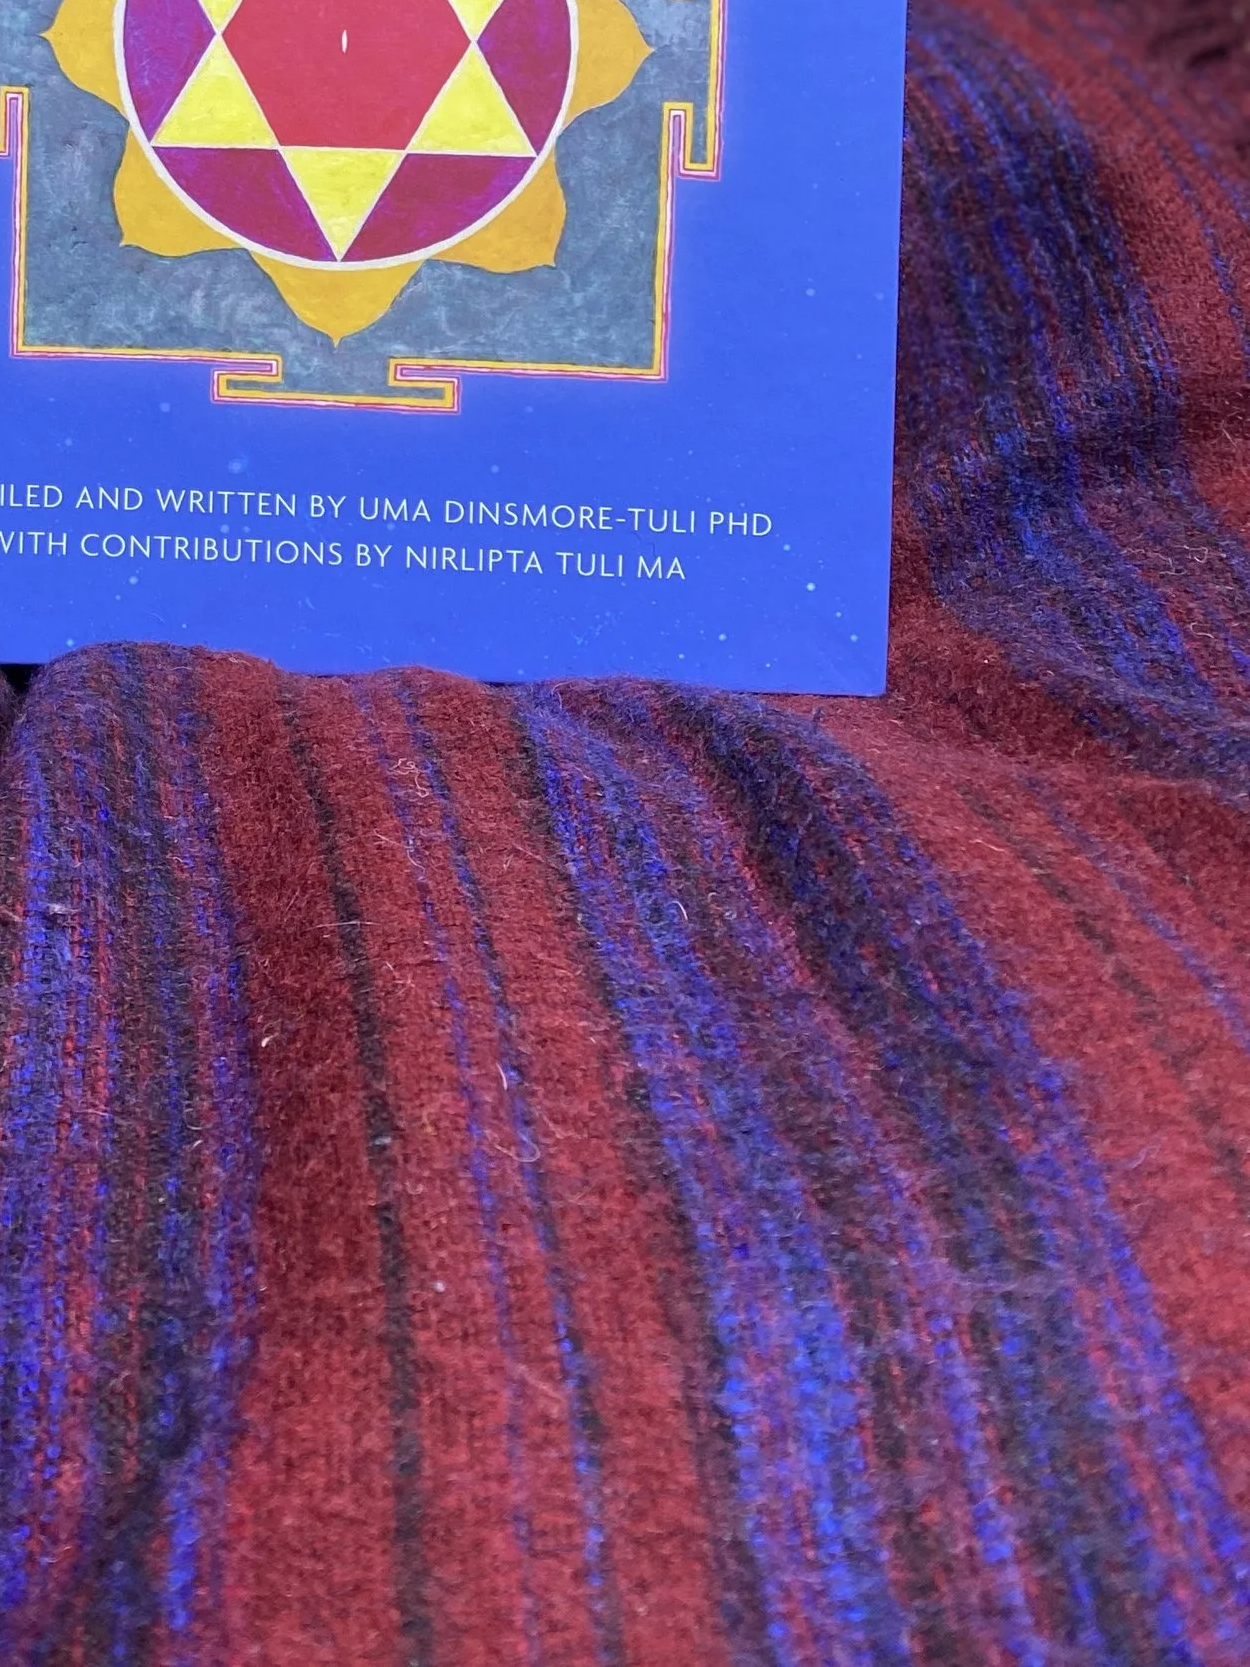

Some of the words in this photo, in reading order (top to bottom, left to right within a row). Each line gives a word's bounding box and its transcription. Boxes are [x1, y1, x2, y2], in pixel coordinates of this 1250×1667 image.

[75, 486, 143, 510] AND
[156, 489, 296, 516] WRITTEN
[310, 494, 346, 518] BY
[360, 496, 431, 522] UMA
[445, 500, 695, 533] DINSMORE-TULI
[710, 511, 772, 536] PHD
[80, 533, 342, 565] CONTRIBUTIONS
[356, 543, 392, 567] BY
[406, 545, 543, 574] NIRLIPTA
[555, 552, 623, 577] TULI
[637, 555, 685, 580] MA
